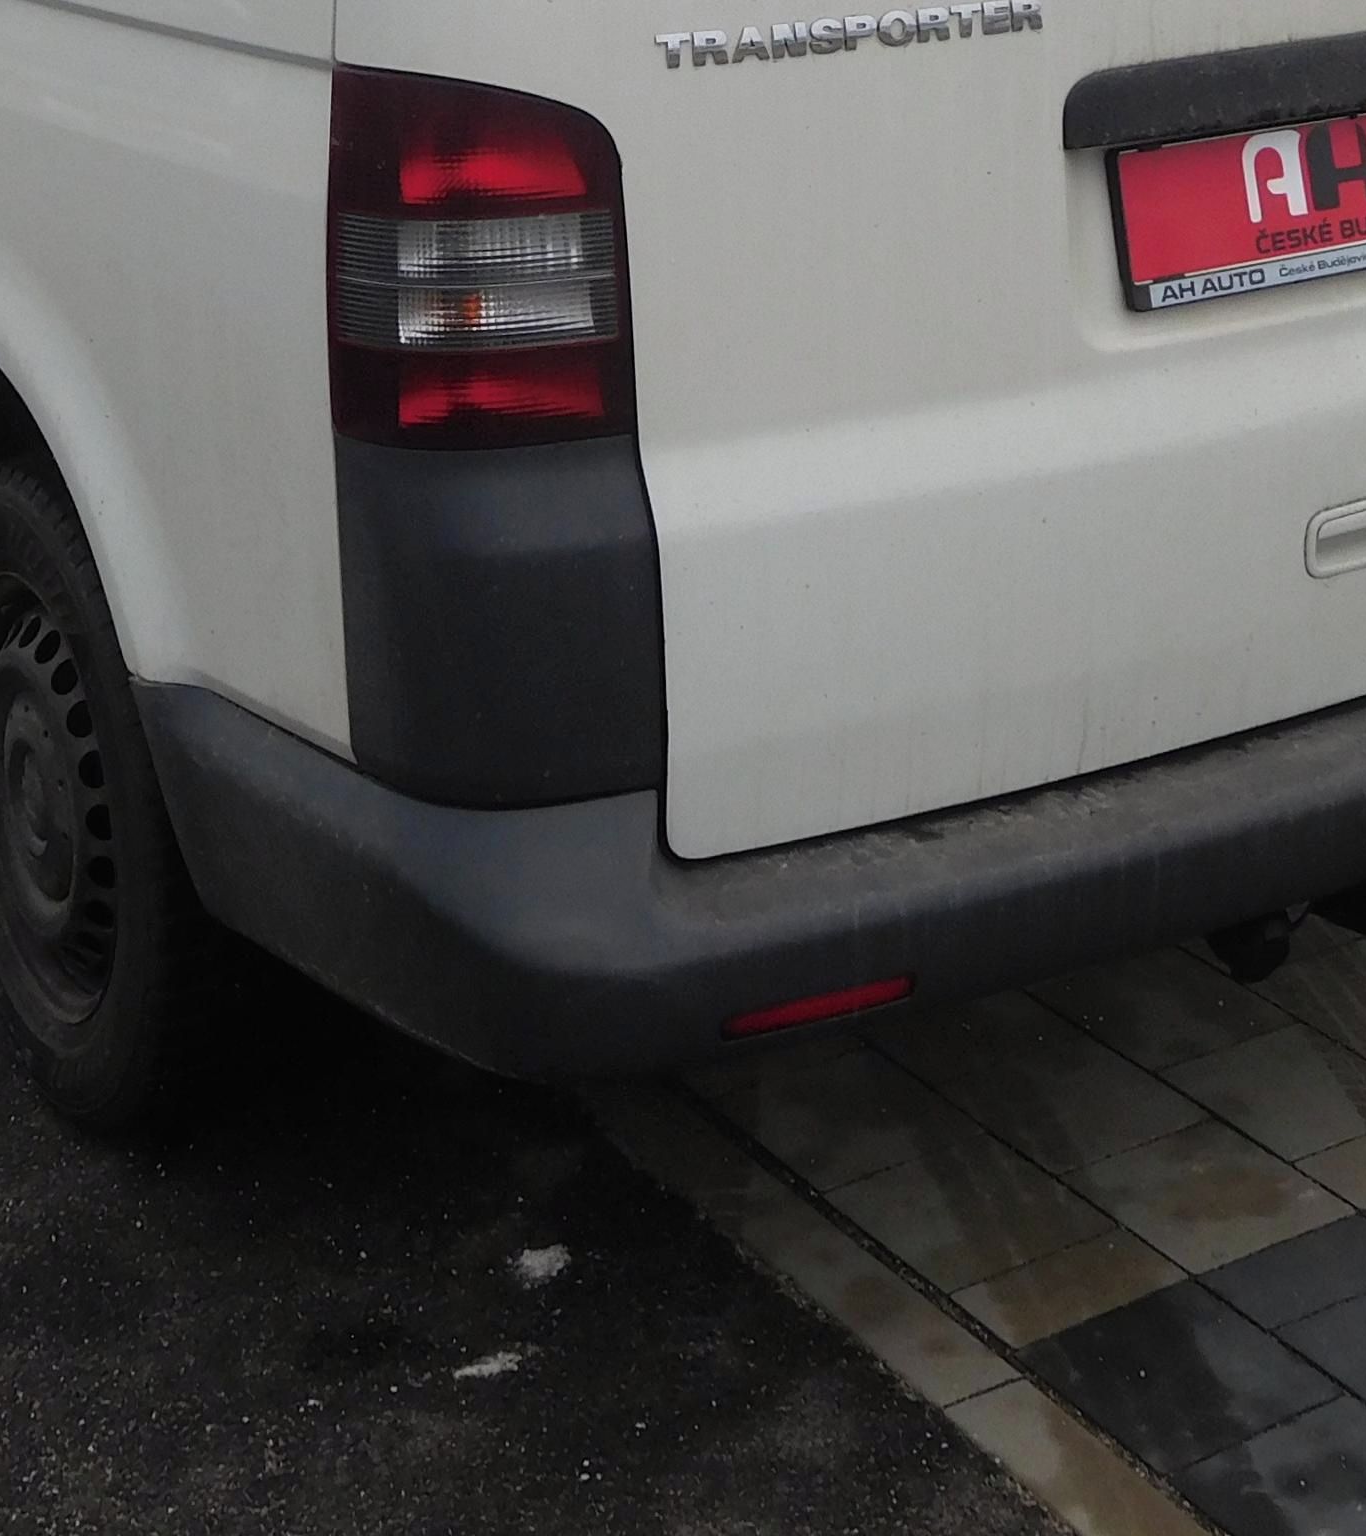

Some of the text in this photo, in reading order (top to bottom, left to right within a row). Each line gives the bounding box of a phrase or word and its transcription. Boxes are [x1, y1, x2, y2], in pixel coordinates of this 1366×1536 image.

[1255, 217, 1333, 255] ČESKÉ
[1160, 267, 1266, 303] AH AUTO
[1278, 260, 1316, 277] České
